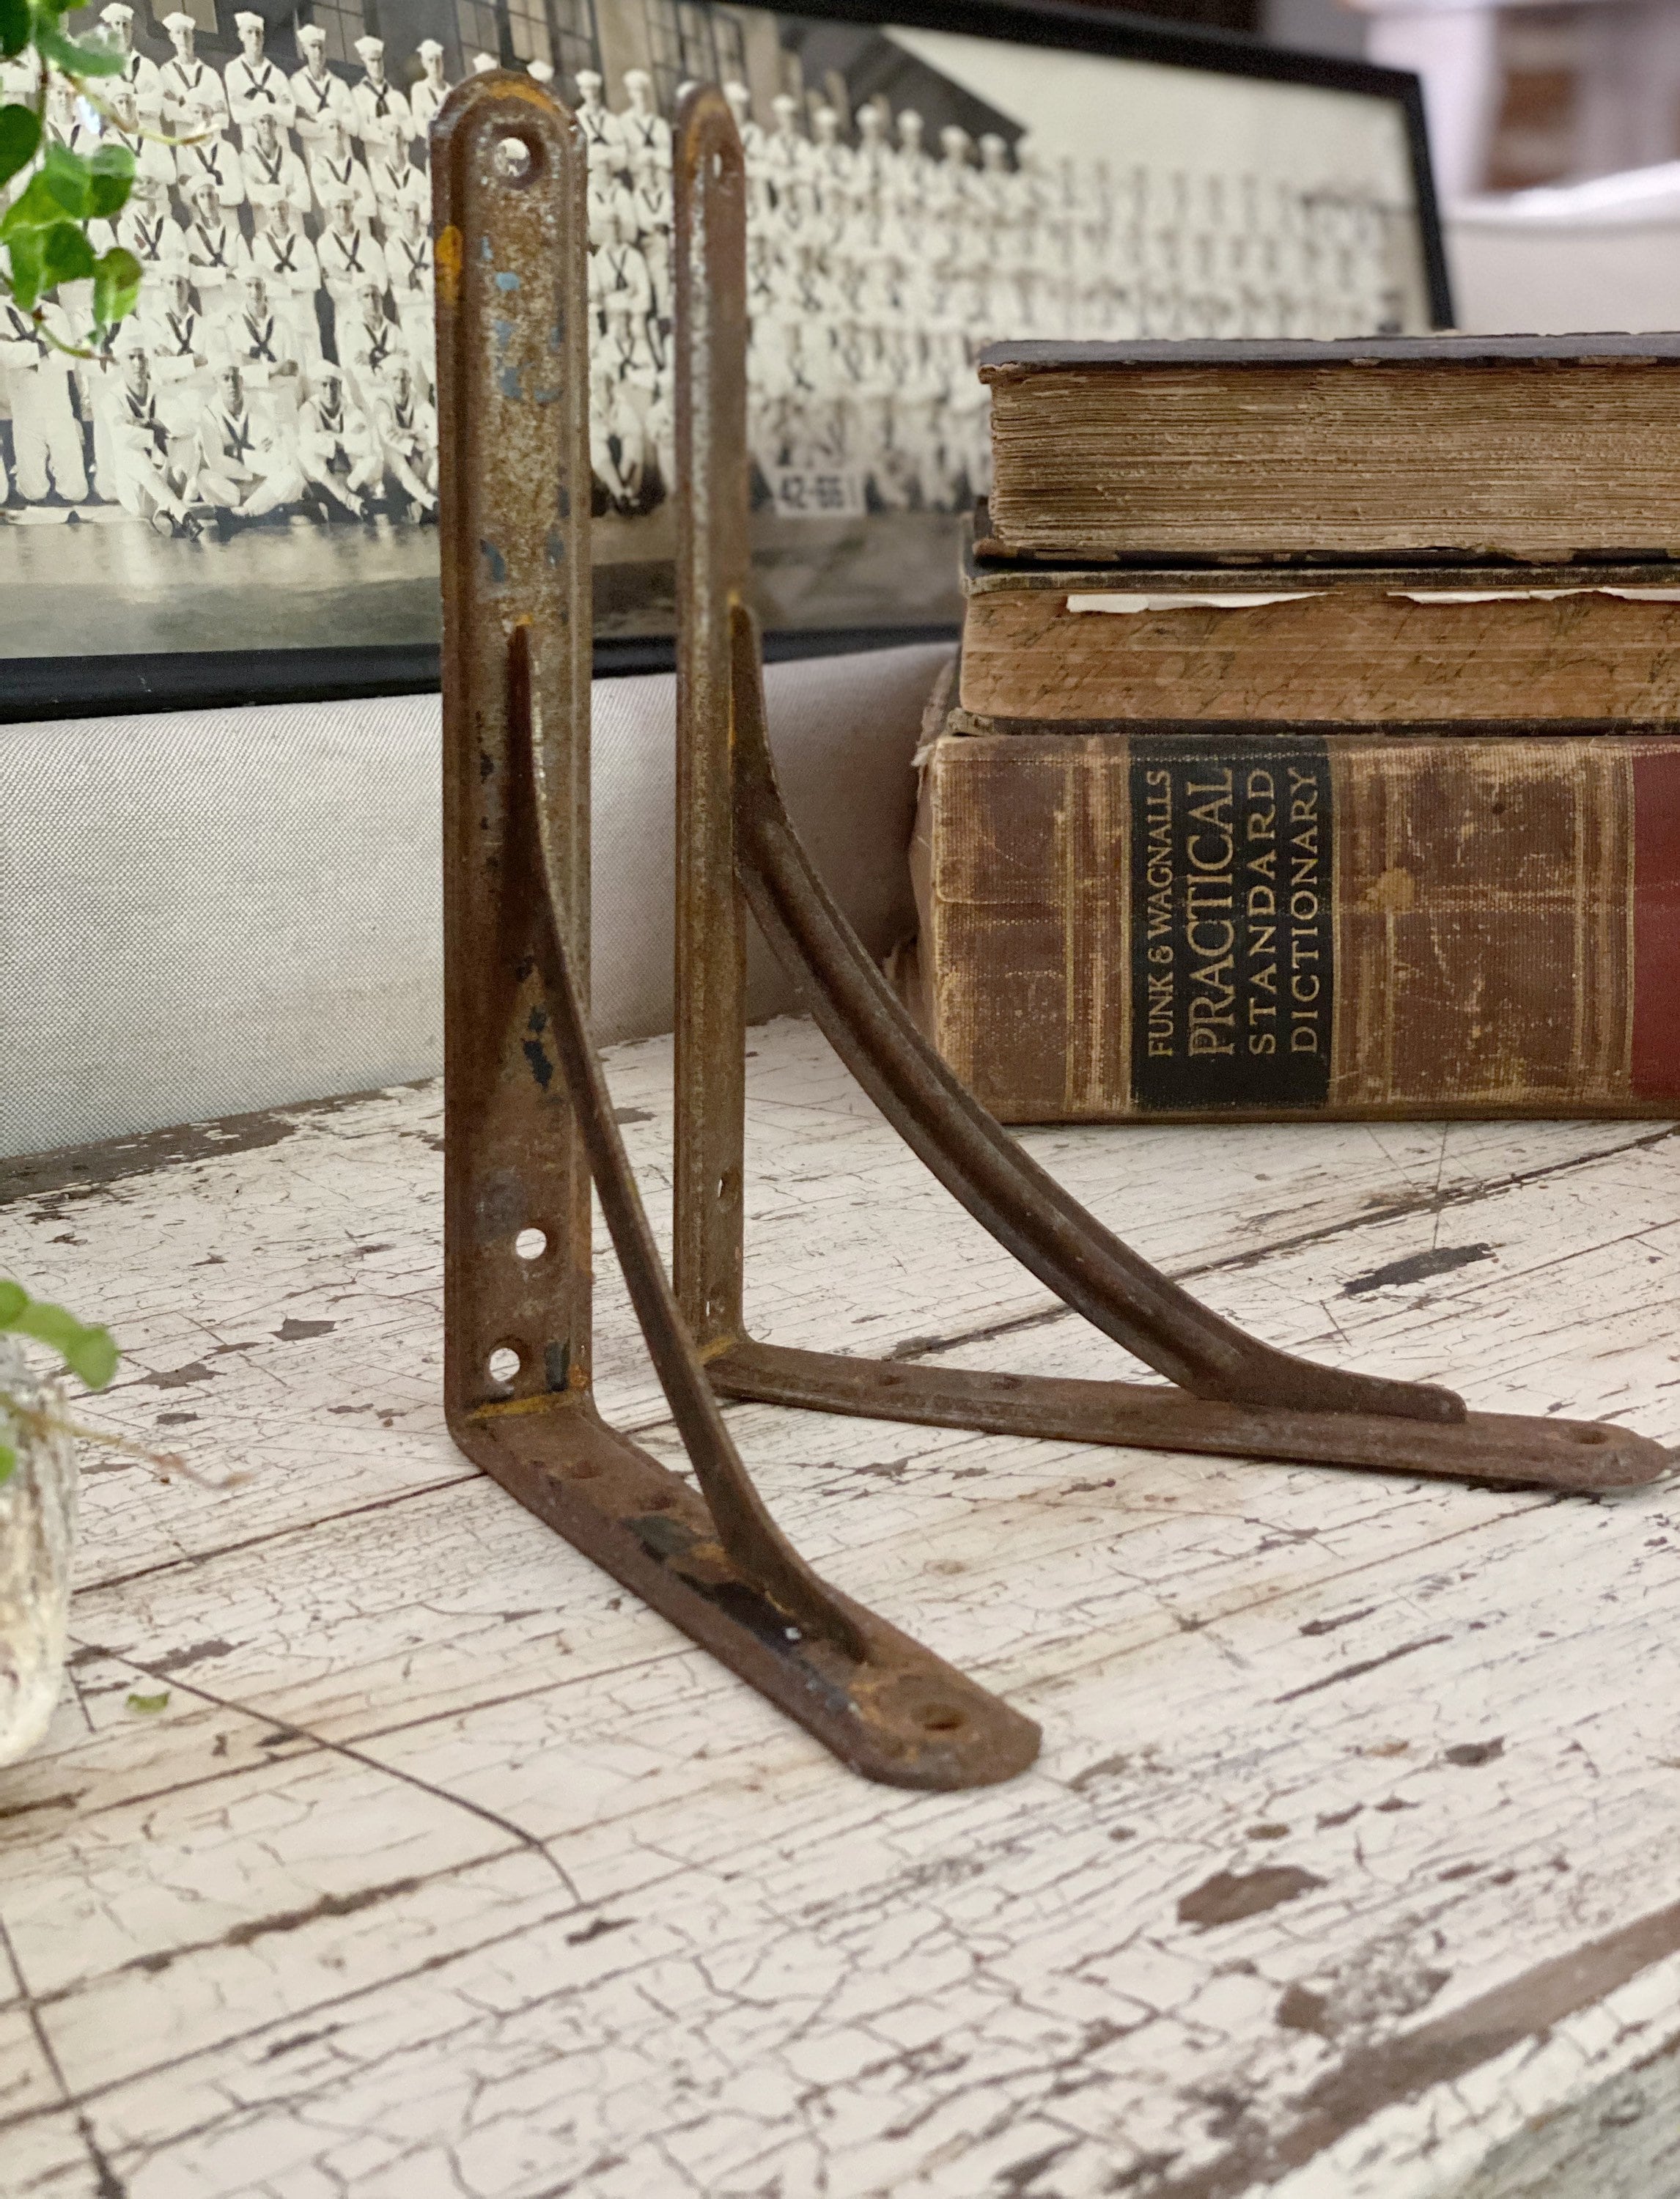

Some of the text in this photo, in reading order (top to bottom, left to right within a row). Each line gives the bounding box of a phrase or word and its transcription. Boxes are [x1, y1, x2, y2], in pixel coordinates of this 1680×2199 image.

[1146, 771, 1174, 1056] FUNK & WAGNALLS
[1187, 767, 1235, 1056] PRACTICAL
[1247, 767, 1277, 1055] STANDARD
[1290, 767, 1320, 1053] DICTIONARY
